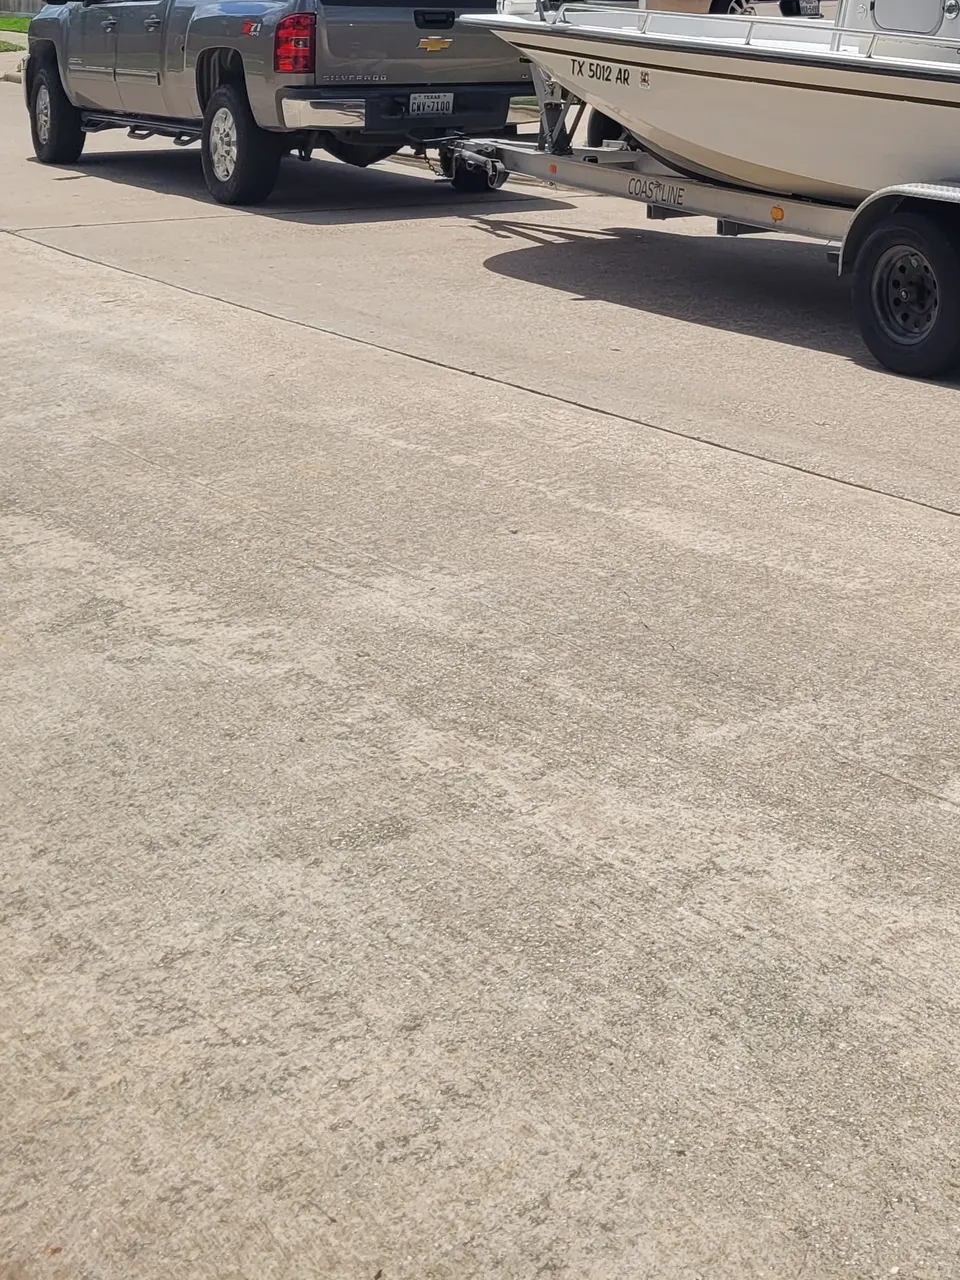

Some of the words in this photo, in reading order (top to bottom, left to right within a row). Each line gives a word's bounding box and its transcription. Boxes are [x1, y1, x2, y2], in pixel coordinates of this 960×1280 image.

[570, 59, 585, 78] TX
[587, 63, 612, 82] 5012
[615, 67, 630, 86] AR
